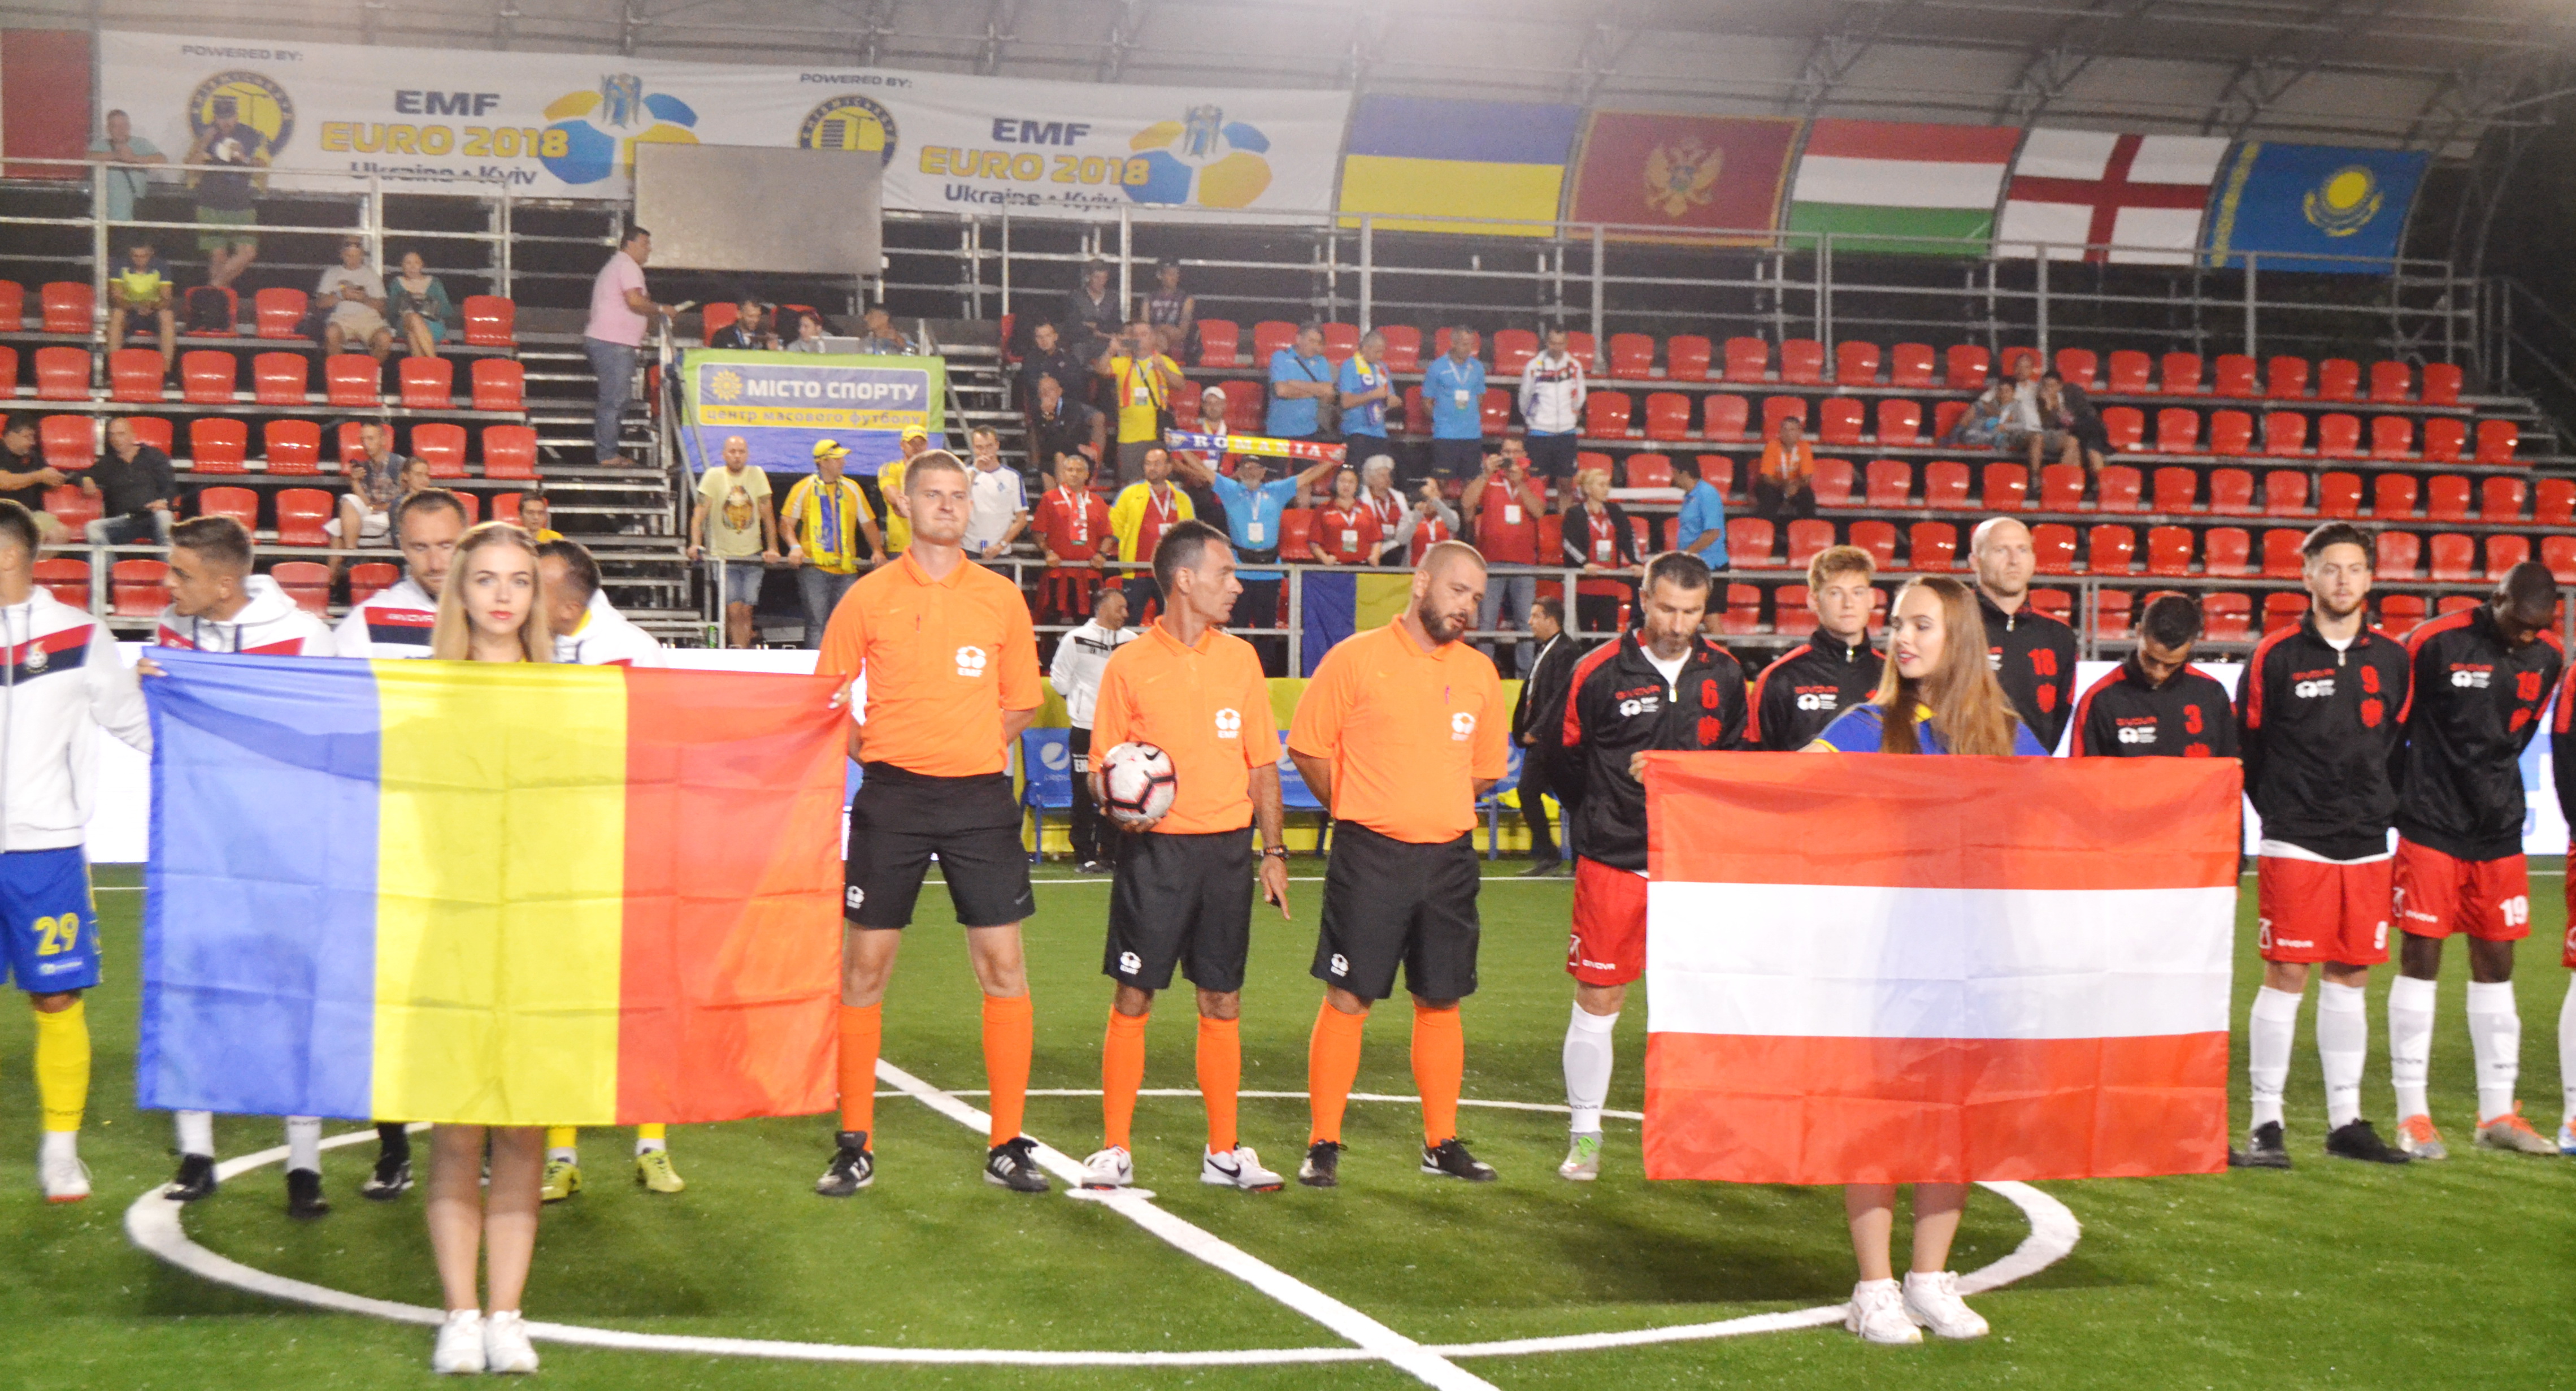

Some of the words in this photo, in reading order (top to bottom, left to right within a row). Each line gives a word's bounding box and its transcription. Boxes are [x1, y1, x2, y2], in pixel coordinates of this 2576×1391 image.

[183, 45, 271, 59] POWERED
[275, 50, 303, 61] BY:
[800, 73, 882, 85] POWERED
[885, 77, 913, 88] BY:
[395, 89, 501, 116] EMF
[321, 121, 454, 155] EURO
[462, 125, 570, 158] 2018
[992, 118, 1091, 146] EMF
[919, 145, 1045, 181] EURO
[1051, 154, 1150, 186] 2018
[944, 183, 1041, 206] Ukraine
[748, 378, 822, 398] МІСТО
[827, 381, 919, 401] СПОРТУ
[706, 409, 758, 423] центр
[763, 410, 844, 424] масового
[849, 408, 921, 426] футболу
[1193, 434, 1322, 458] ROMANIA
[957, 667, 983, 677] EMF
[2360, 665, 2380, 694] 9
[1701, 679, 1719, 709] 6
[2183, 704, 2203, 734] 3
[1218, 730, 1239, 739] EMF
[2499, 895, 2529, 927] 19
[34, 912, 79, 956] 29
[2374, 920, 2389, 950] 9
